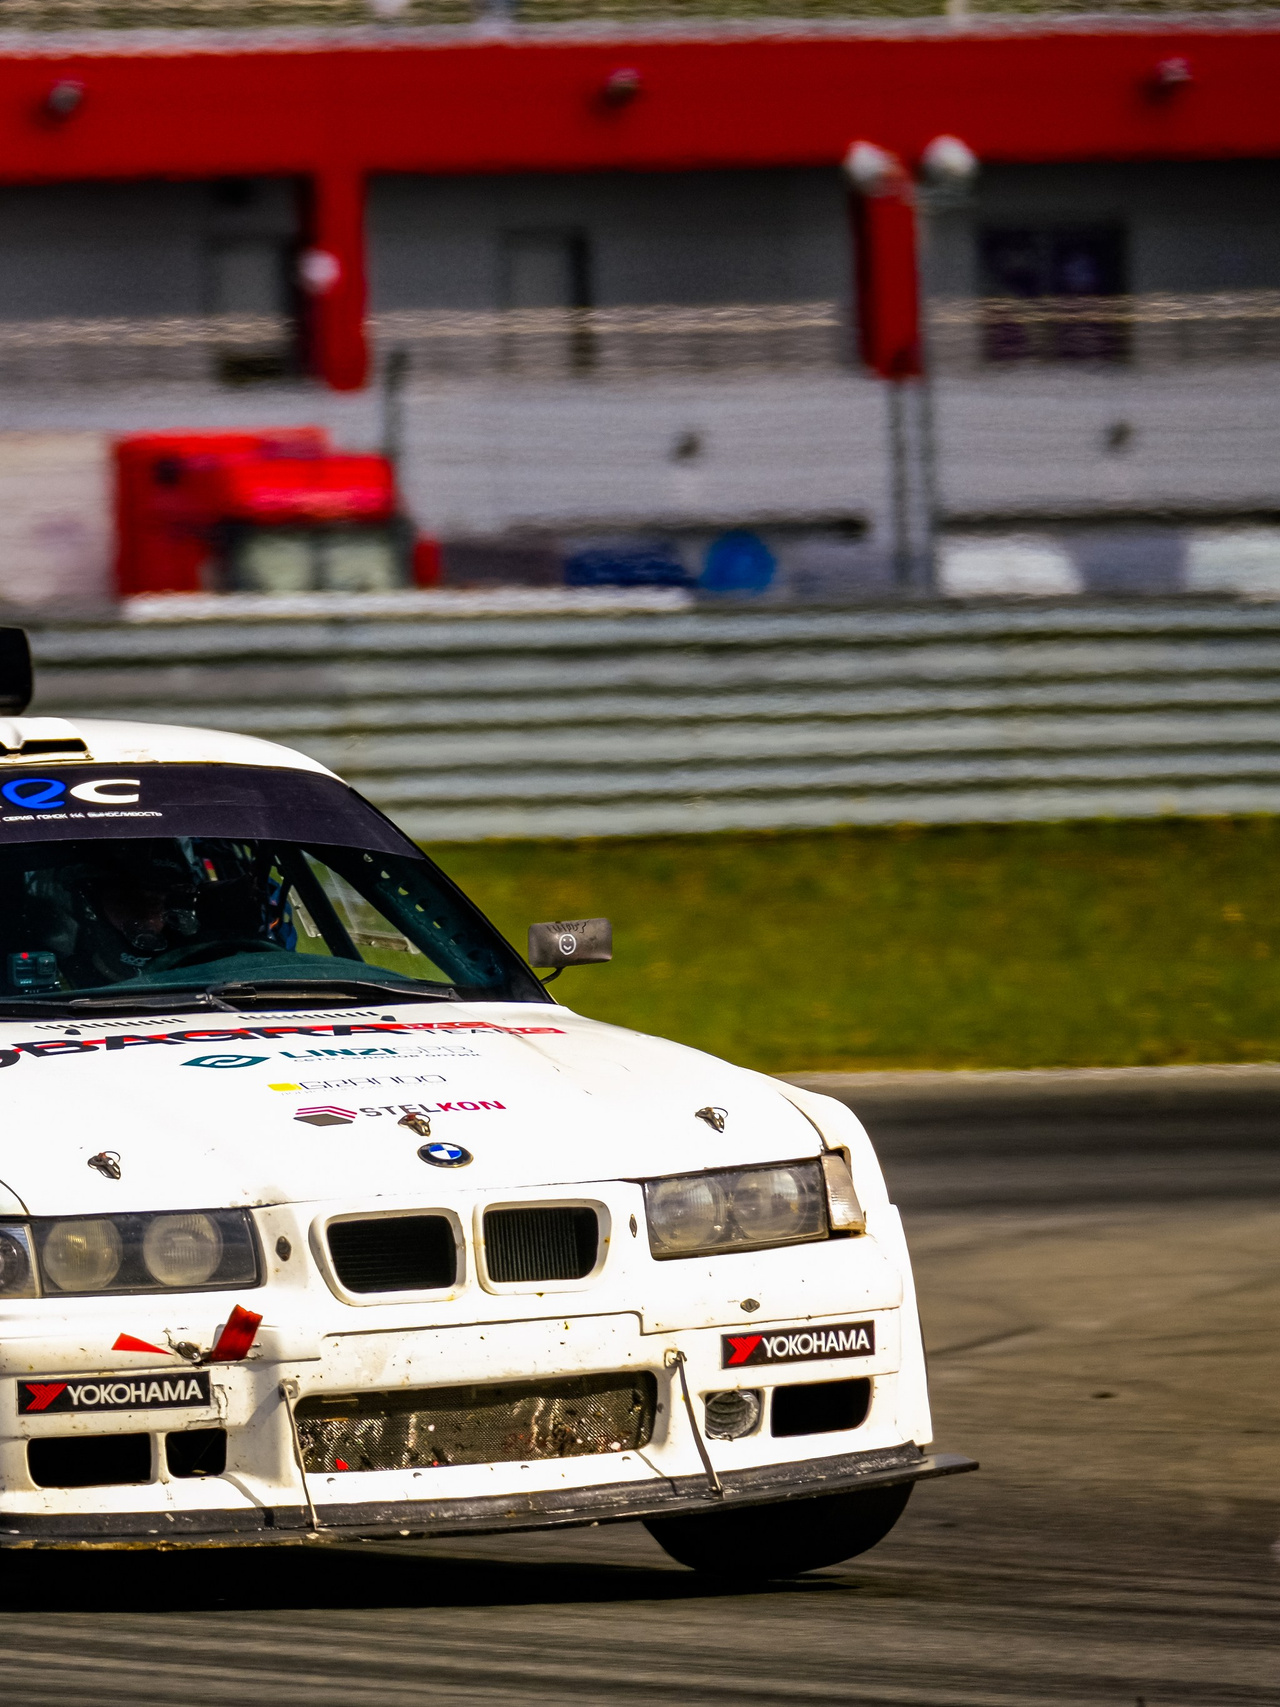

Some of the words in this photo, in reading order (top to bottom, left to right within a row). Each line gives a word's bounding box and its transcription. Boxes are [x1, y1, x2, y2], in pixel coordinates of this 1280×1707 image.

[36, 813, 68, 821] ГОНОК
[359, 1100, 507, 1117] STELKON
[762, 1328, 870, 1358] YOKOHAMA
[66, 1379, 204, 1407] YOKOHAMA
